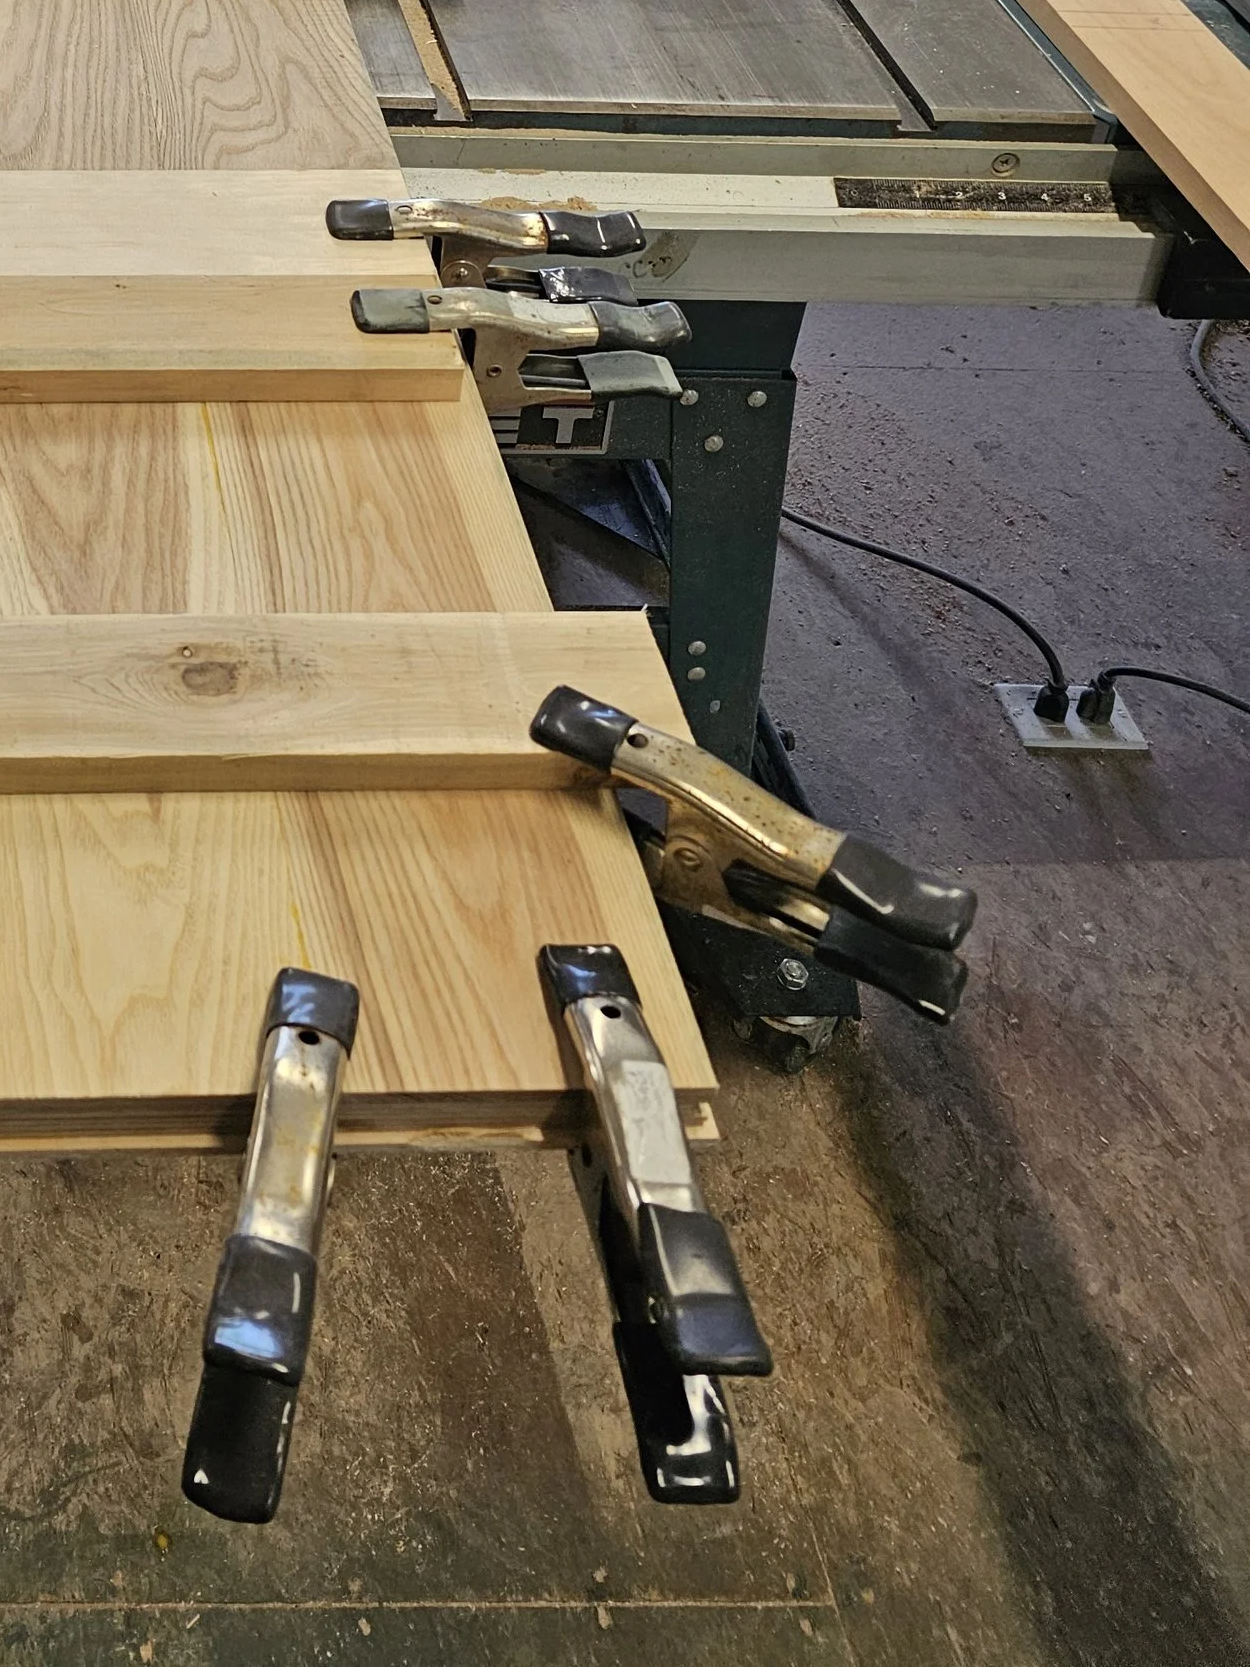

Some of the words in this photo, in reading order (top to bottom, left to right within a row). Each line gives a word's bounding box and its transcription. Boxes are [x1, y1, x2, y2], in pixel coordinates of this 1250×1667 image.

[954, 190, 964, 200] 2
[997, 191, 1007, 201] 3
[1040, 192, 1050, 202] 4
[1083, 192, 1093, 202] 5
